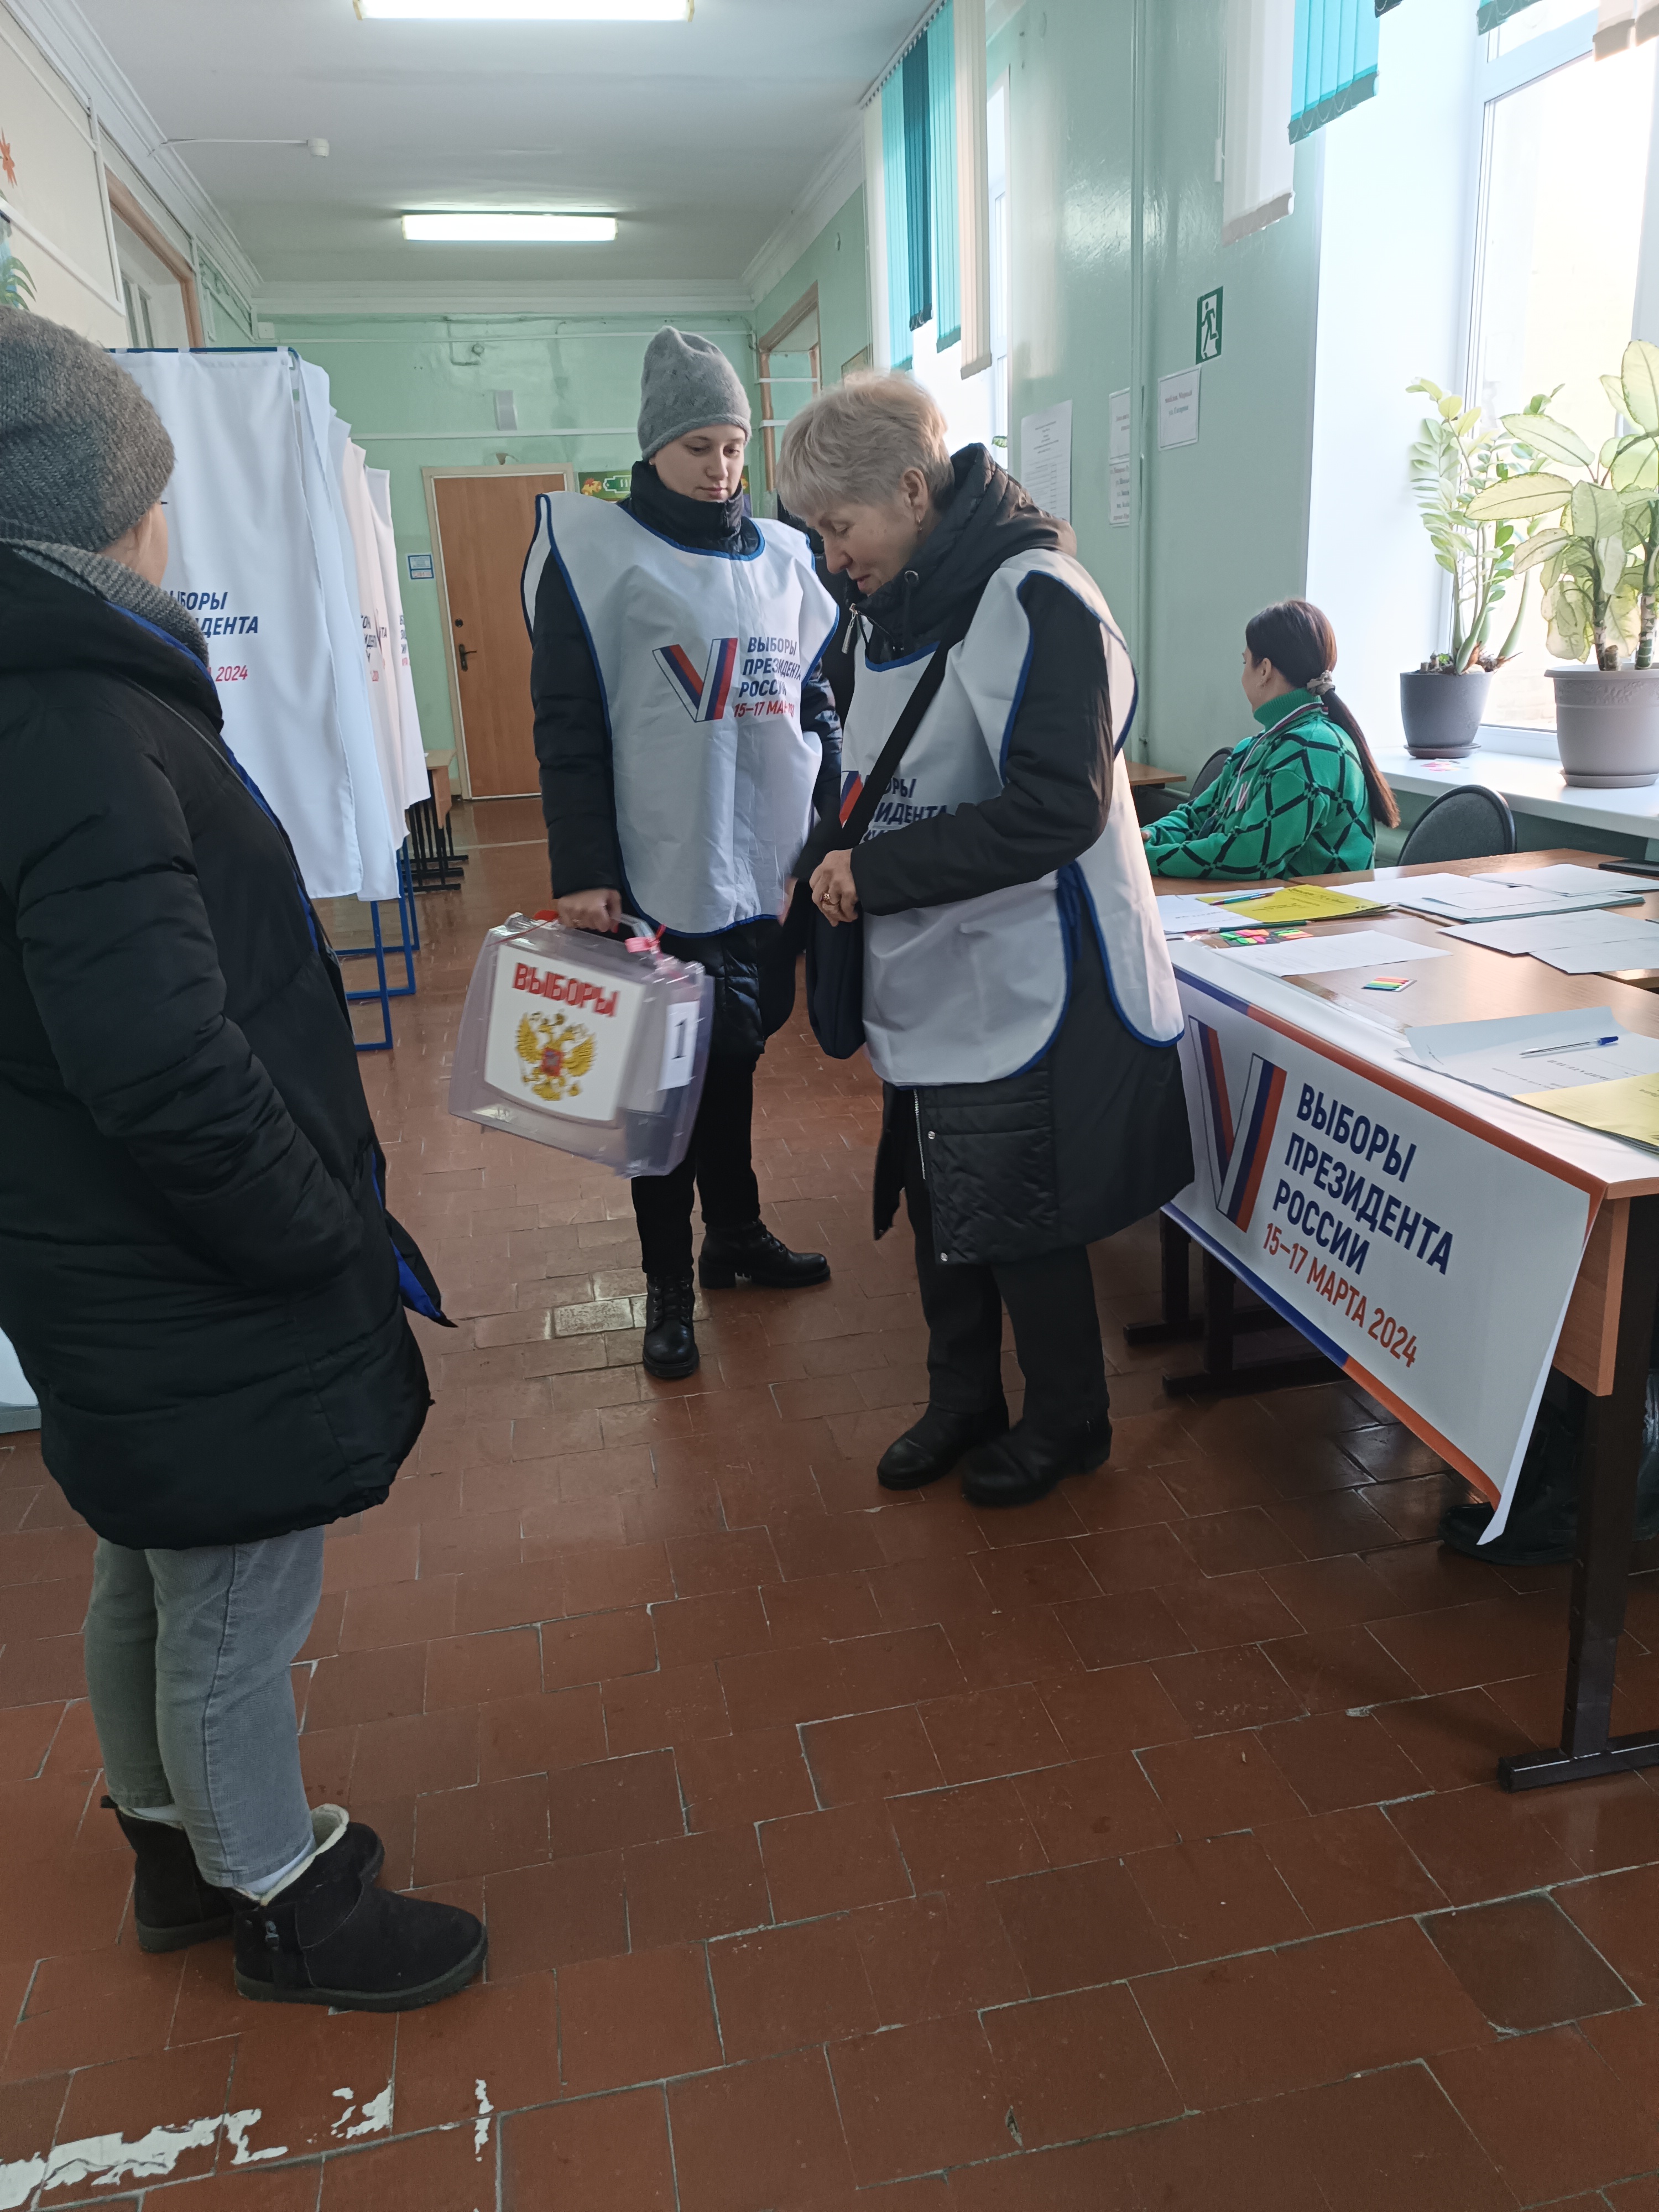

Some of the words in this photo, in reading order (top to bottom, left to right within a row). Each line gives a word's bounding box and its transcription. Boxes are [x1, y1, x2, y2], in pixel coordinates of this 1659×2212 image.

[170, 591, 228, 610] БОРЫ
[748, 637, 797, 656] ВЫБОРЫ
[215, 665, 248, 682] 2024
[743, 658, 801, 680] ПРЕЗИДЕНТА
[738, 679, 786, 697] РОССИИ
[874, 802, 947, 825] ИДЕНТ
[512, 962, 620, 1017] ВЫБОРЫ
[1296, 1083, 1417, 1182] ВЫБОРЫ
[1284, 1132, 1454, 1275] ПРЕЗИДЕНТА
[1272, 1178, 1370, 1275] РОССИИ
[1306, 1258, 1368, 1328] МАРТА
[1368, 1308, 1418, 1368] 2024
